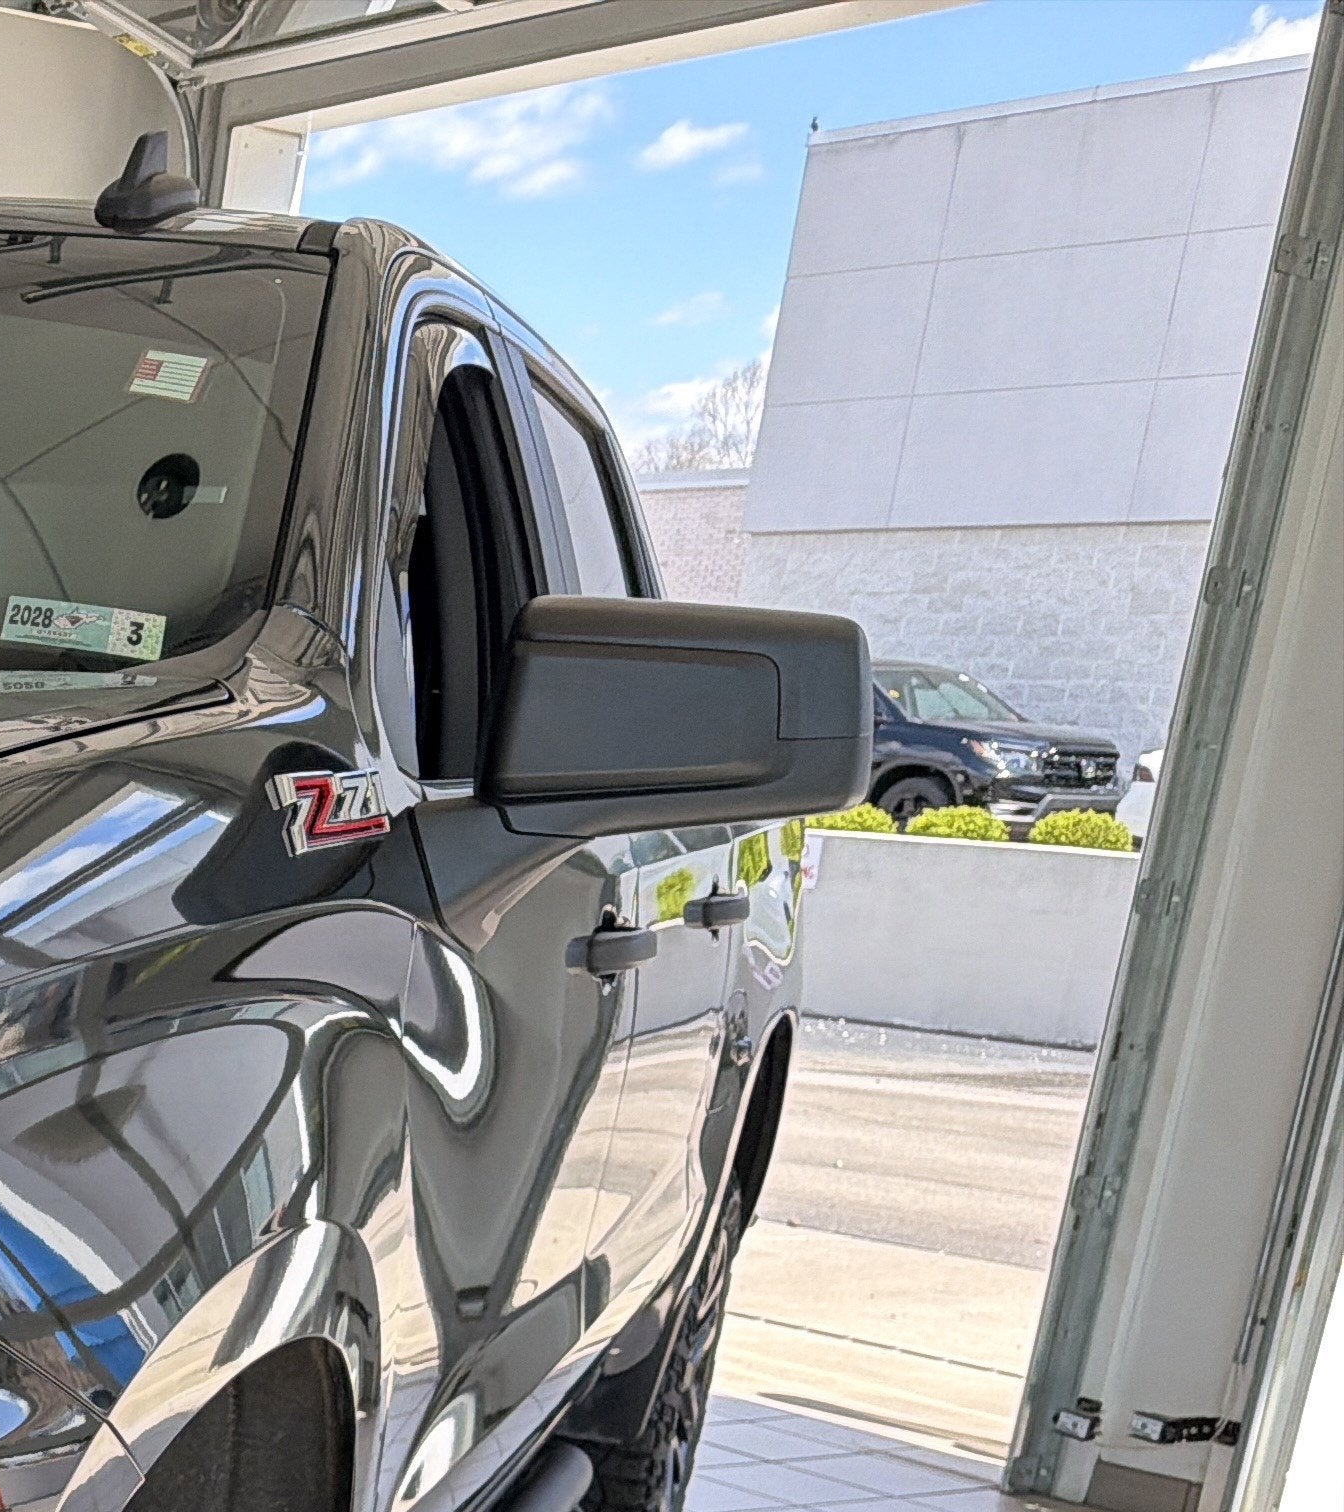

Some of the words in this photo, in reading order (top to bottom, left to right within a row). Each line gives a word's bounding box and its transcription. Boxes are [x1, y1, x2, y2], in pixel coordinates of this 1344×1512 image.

[8, 604, 55, 629] 2028
[126, 621, 145, 646] 3
[265, 768, 391, 858] Z71
